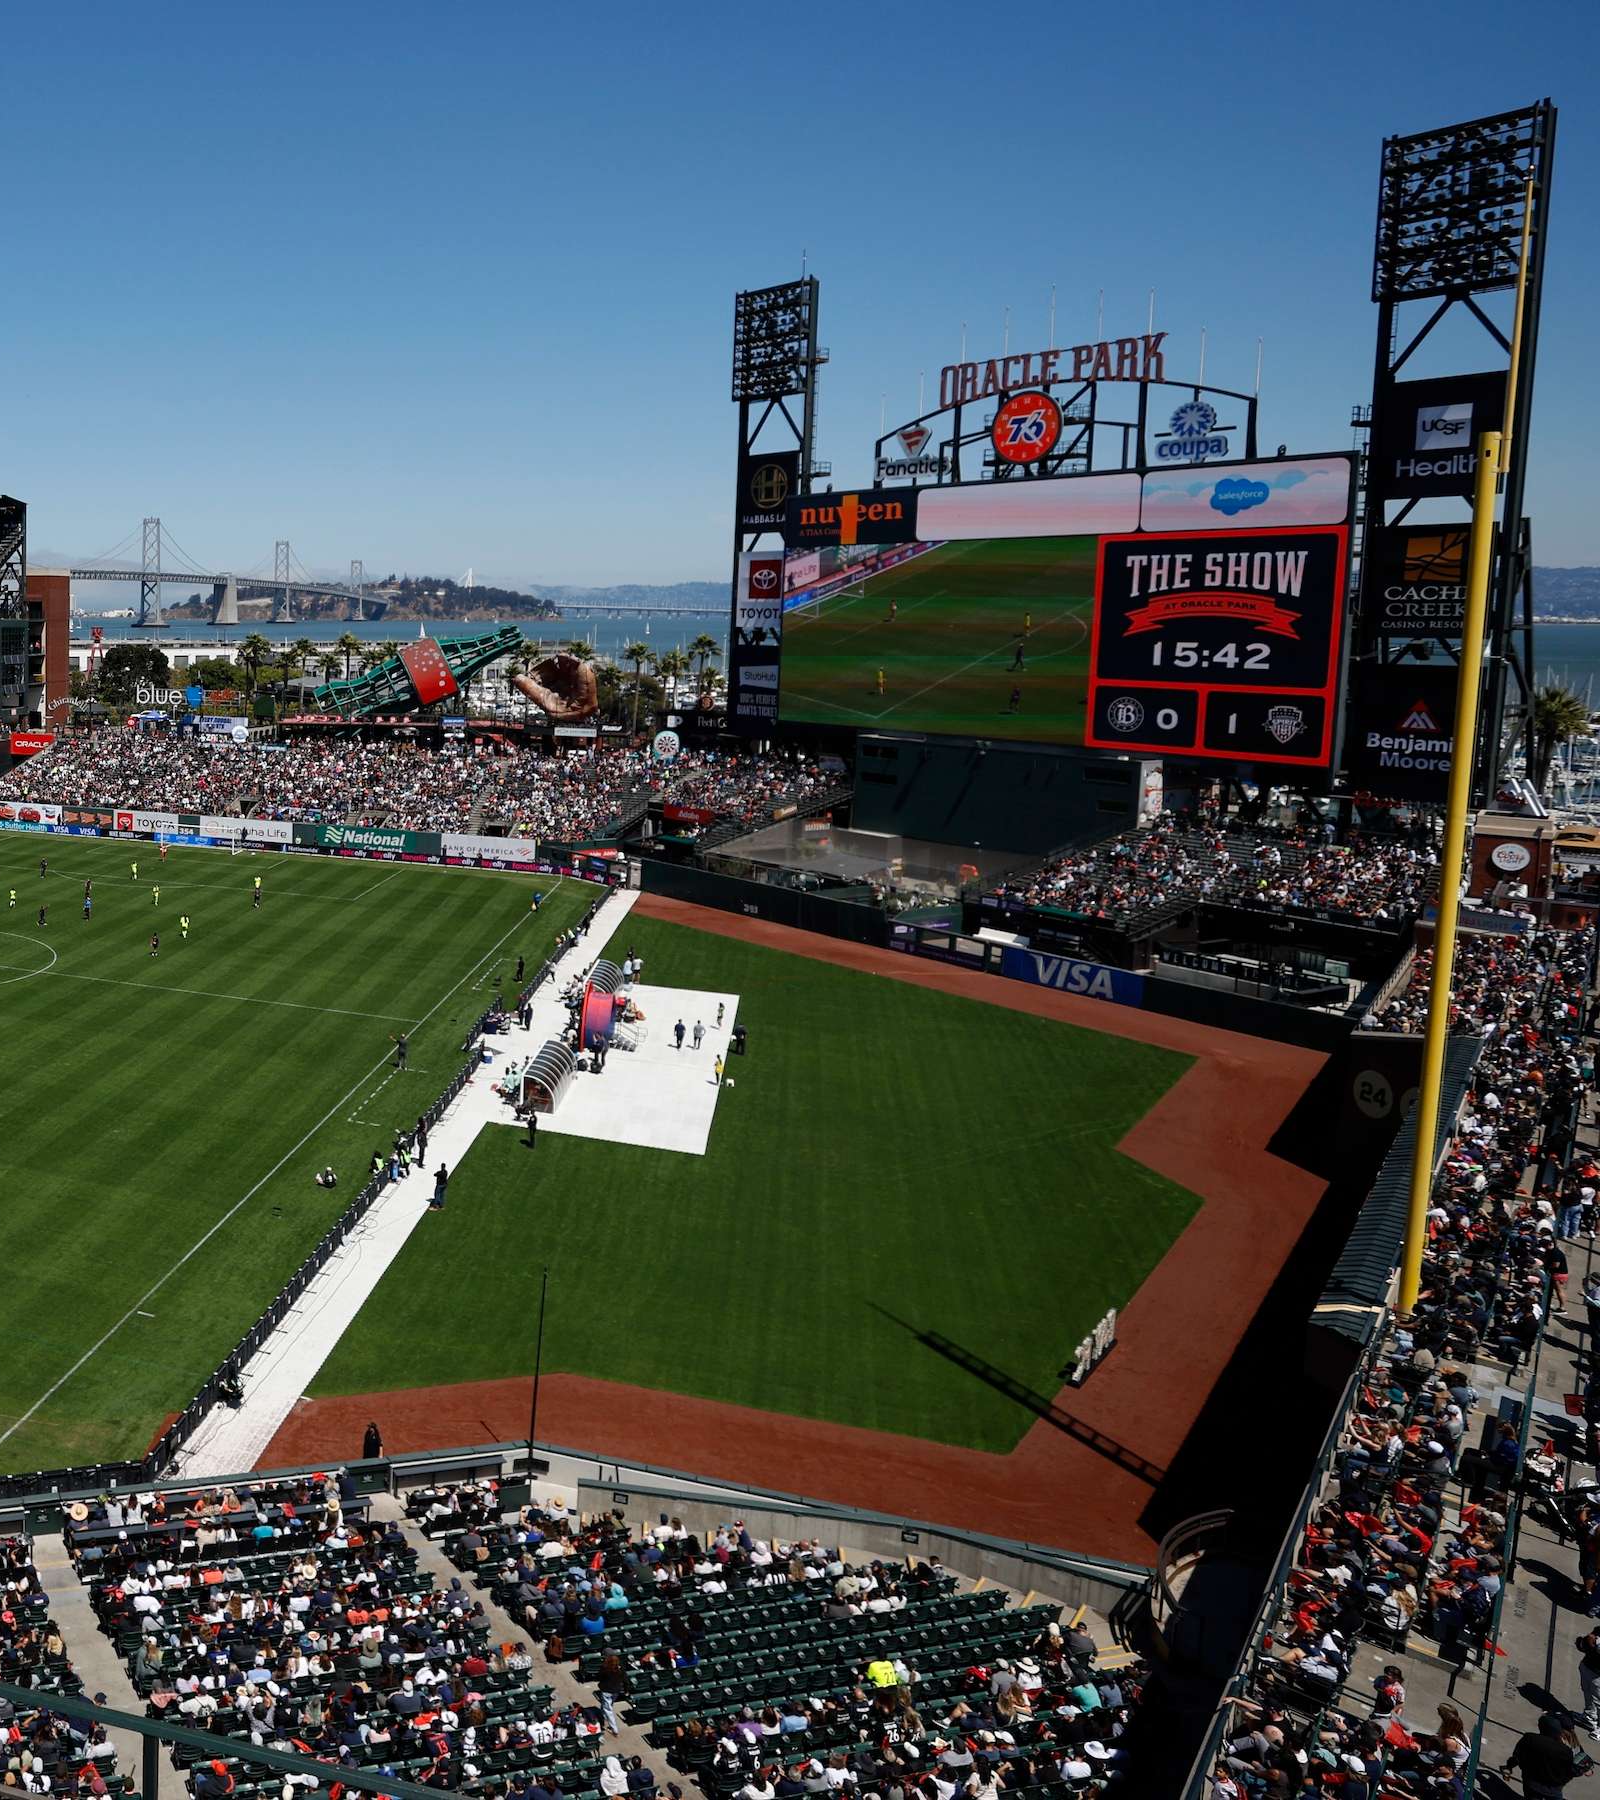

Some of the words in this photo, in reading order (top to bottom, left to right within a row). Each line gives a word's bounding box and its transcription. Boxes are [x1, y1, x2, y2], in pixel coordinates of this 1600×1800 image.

[939, 350, 1060, 410] ORACLE
[1072, 332, 1169, 383] PARK
[1007, 408, 1046, 444] 76
[1422, 418, 1466, 436] UCSF
[1157, 438, 1223, 461] coupa
[876, 455, 951, 479] Fanatics
[1217, 487, 1265, 501] salesforce
[742, 514, 775, 524] HABBAS
[1126, 553, 1193, 598] THE
[1204, 550, 1309, 597] SHOW
[740, 607, 782, 619] TOYOT
[1180, 600, 1223, 608] ORACLE
[1227, 601, 1257, 611] PARK
[1381, 620, 1426, 629] CASINO
[1152, 641, 1271, 670] 15:42
[136, 684, 183, 705] blue
[1155, 708, 1178, 730] 0
[1228, 712, 1238, 734] 1
[1366, 731, 1453, 753] Benjami
[1379, 751, 1451, 772] Moore
[4, 820, 25, 830] Sutter
[25, 822, 48, 832] Health
[52, 825, 69, 834] VISA
[79, 827, 96, 836] VISA
[136, 818, 176, 830] TOYOTA
[221, 824, 266, 837] Hanha
[267, 826, 288, 838] Life
[343, 829, 406, 846] National
[339, 848, 367, 858] epically
[477, 846, 514, 856] AMERICA
[1162, 950, 1229, 974] WELCOME
[1029, 953, 1114, 999] VISA
[1360, 1081, 1386, 1107] 24
[887, 1729, 900, 1743] 26
[436, 1740, 449, 1754] 13
[754, 1755, 761, 1770] 6
